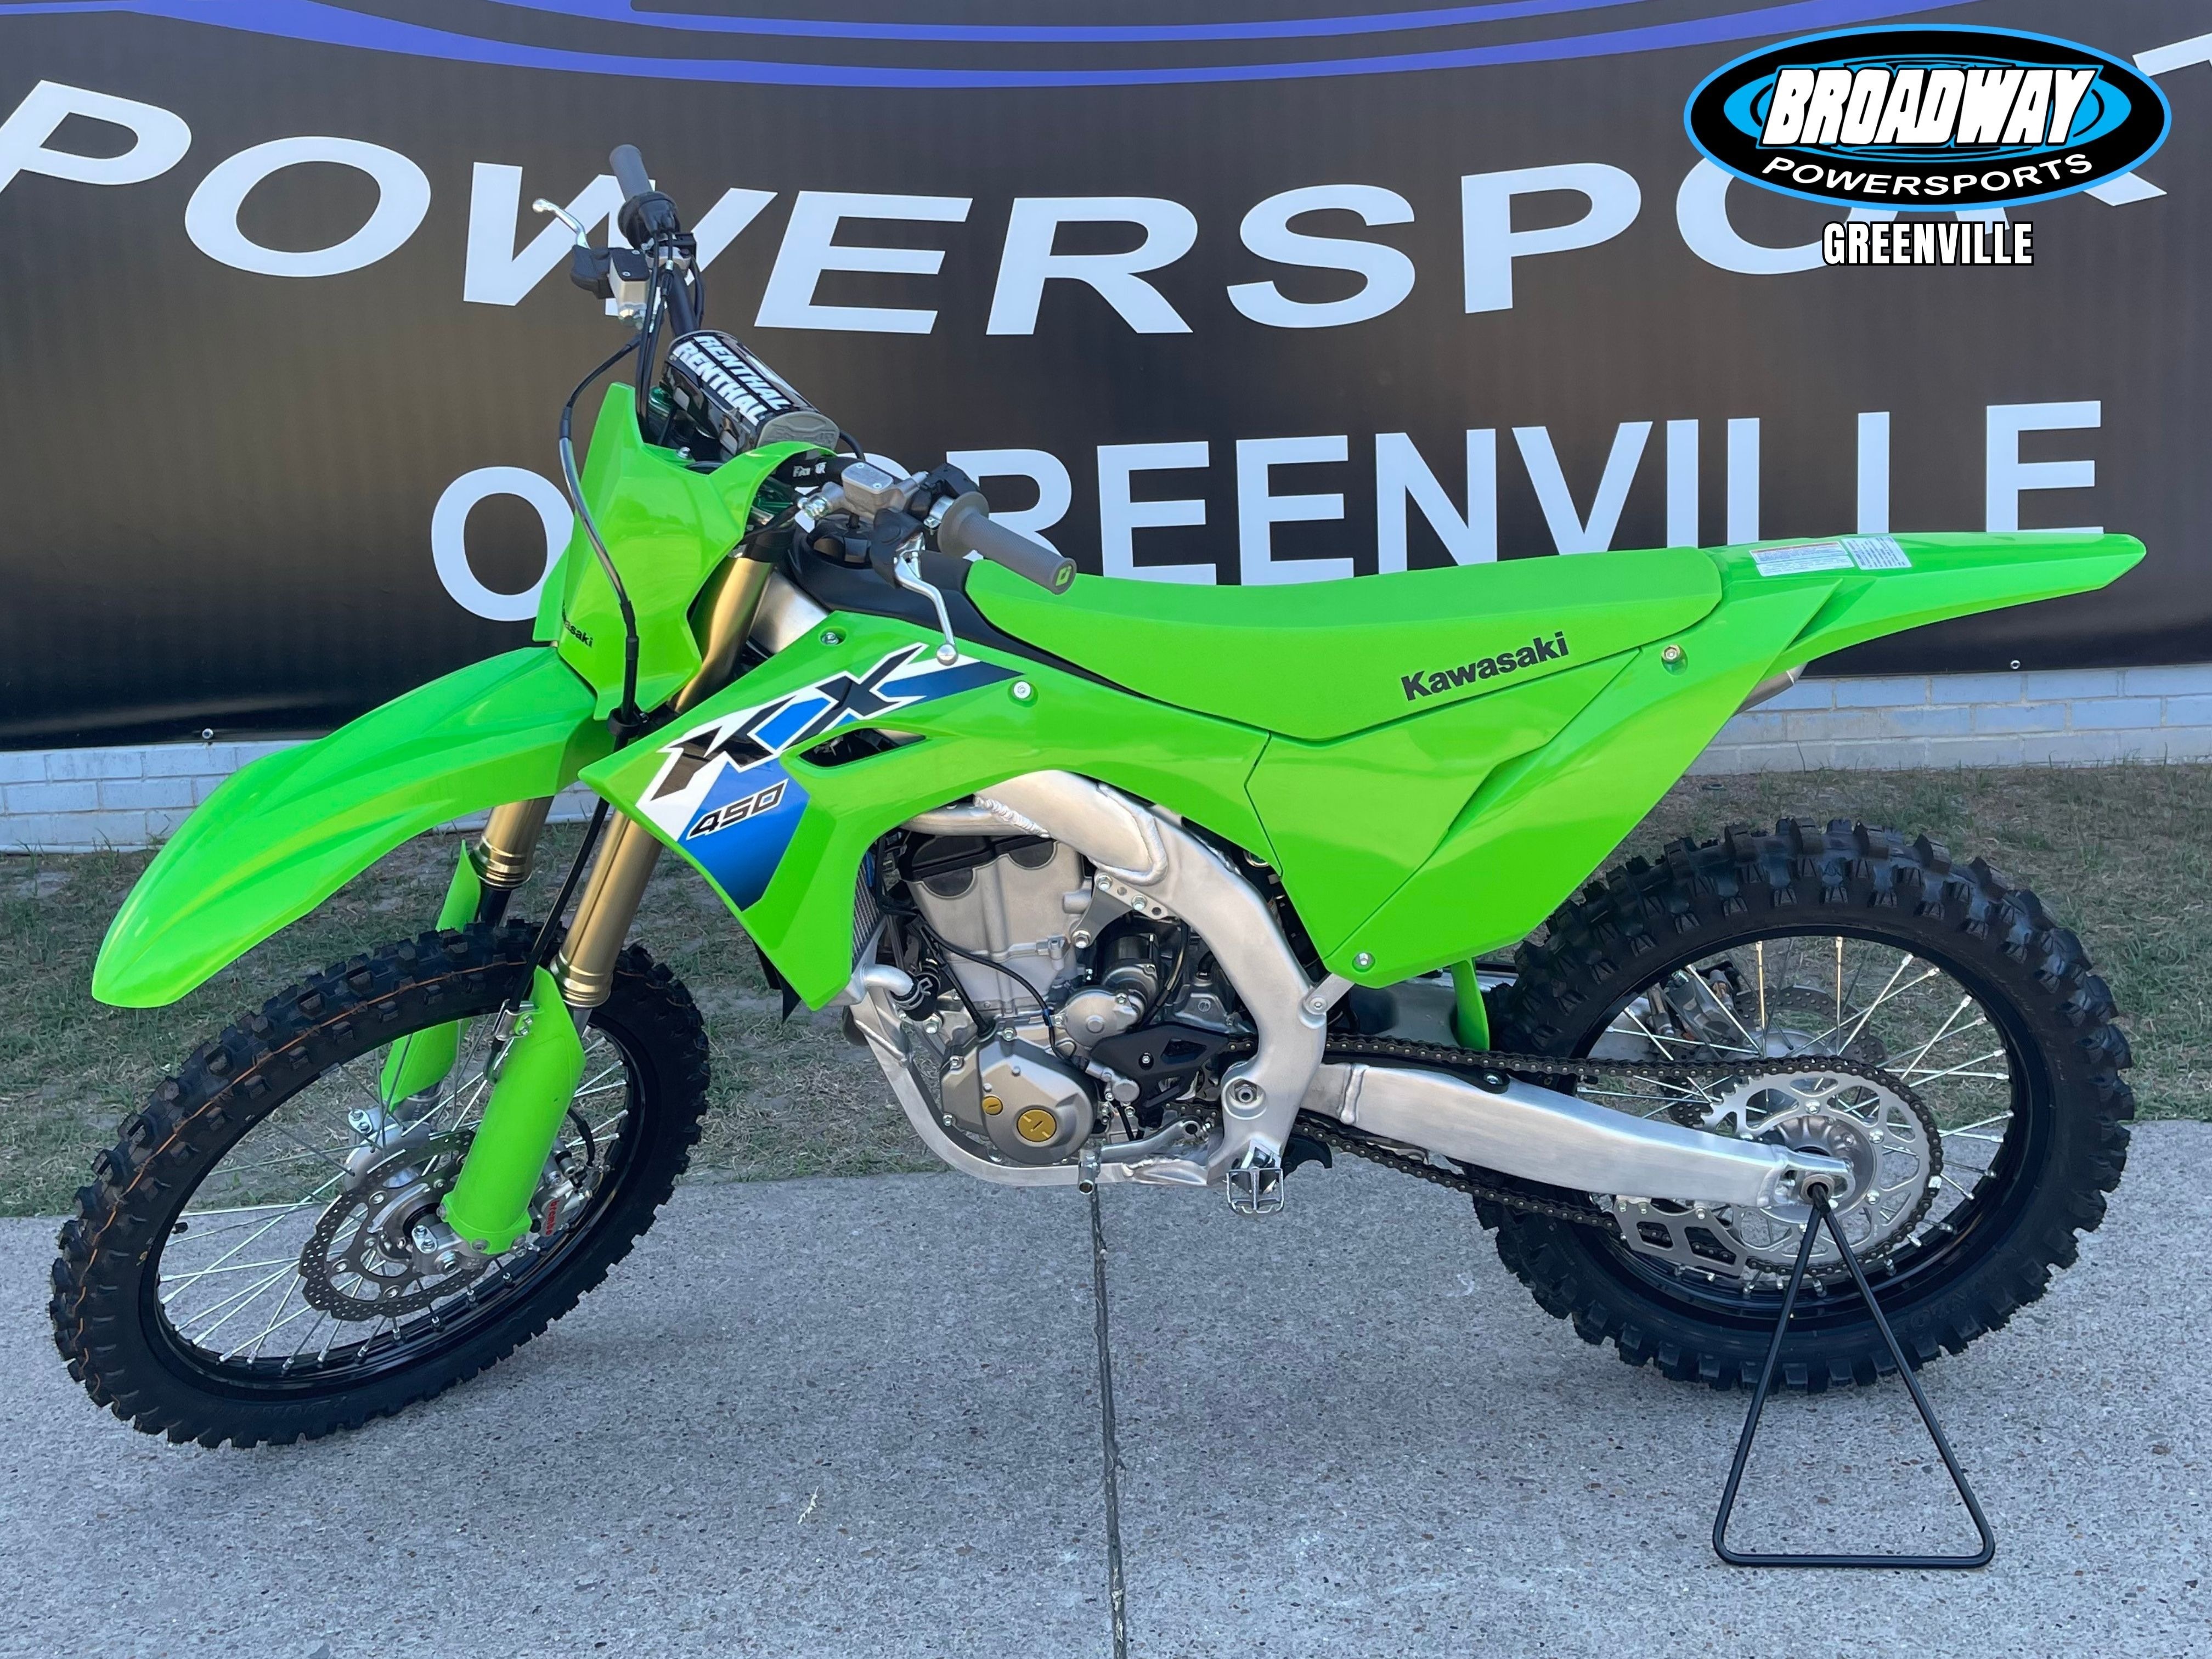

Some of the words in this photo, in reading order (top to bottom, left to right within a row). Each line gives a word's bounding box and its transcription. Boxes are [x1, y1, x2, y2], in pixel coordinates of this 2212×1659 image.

[673, 341, 768, 426] RENTHAL
[693, 335, 793, 411] RENTHAL
[794, 400, 2104, 585] REENVILLE
[1401, 631, 1570, 702] Kawasaki
[650, 643, 926, 803] KX
[687, 780, 787, 840] 450
[546, 1200, 560, 1235] brembo
